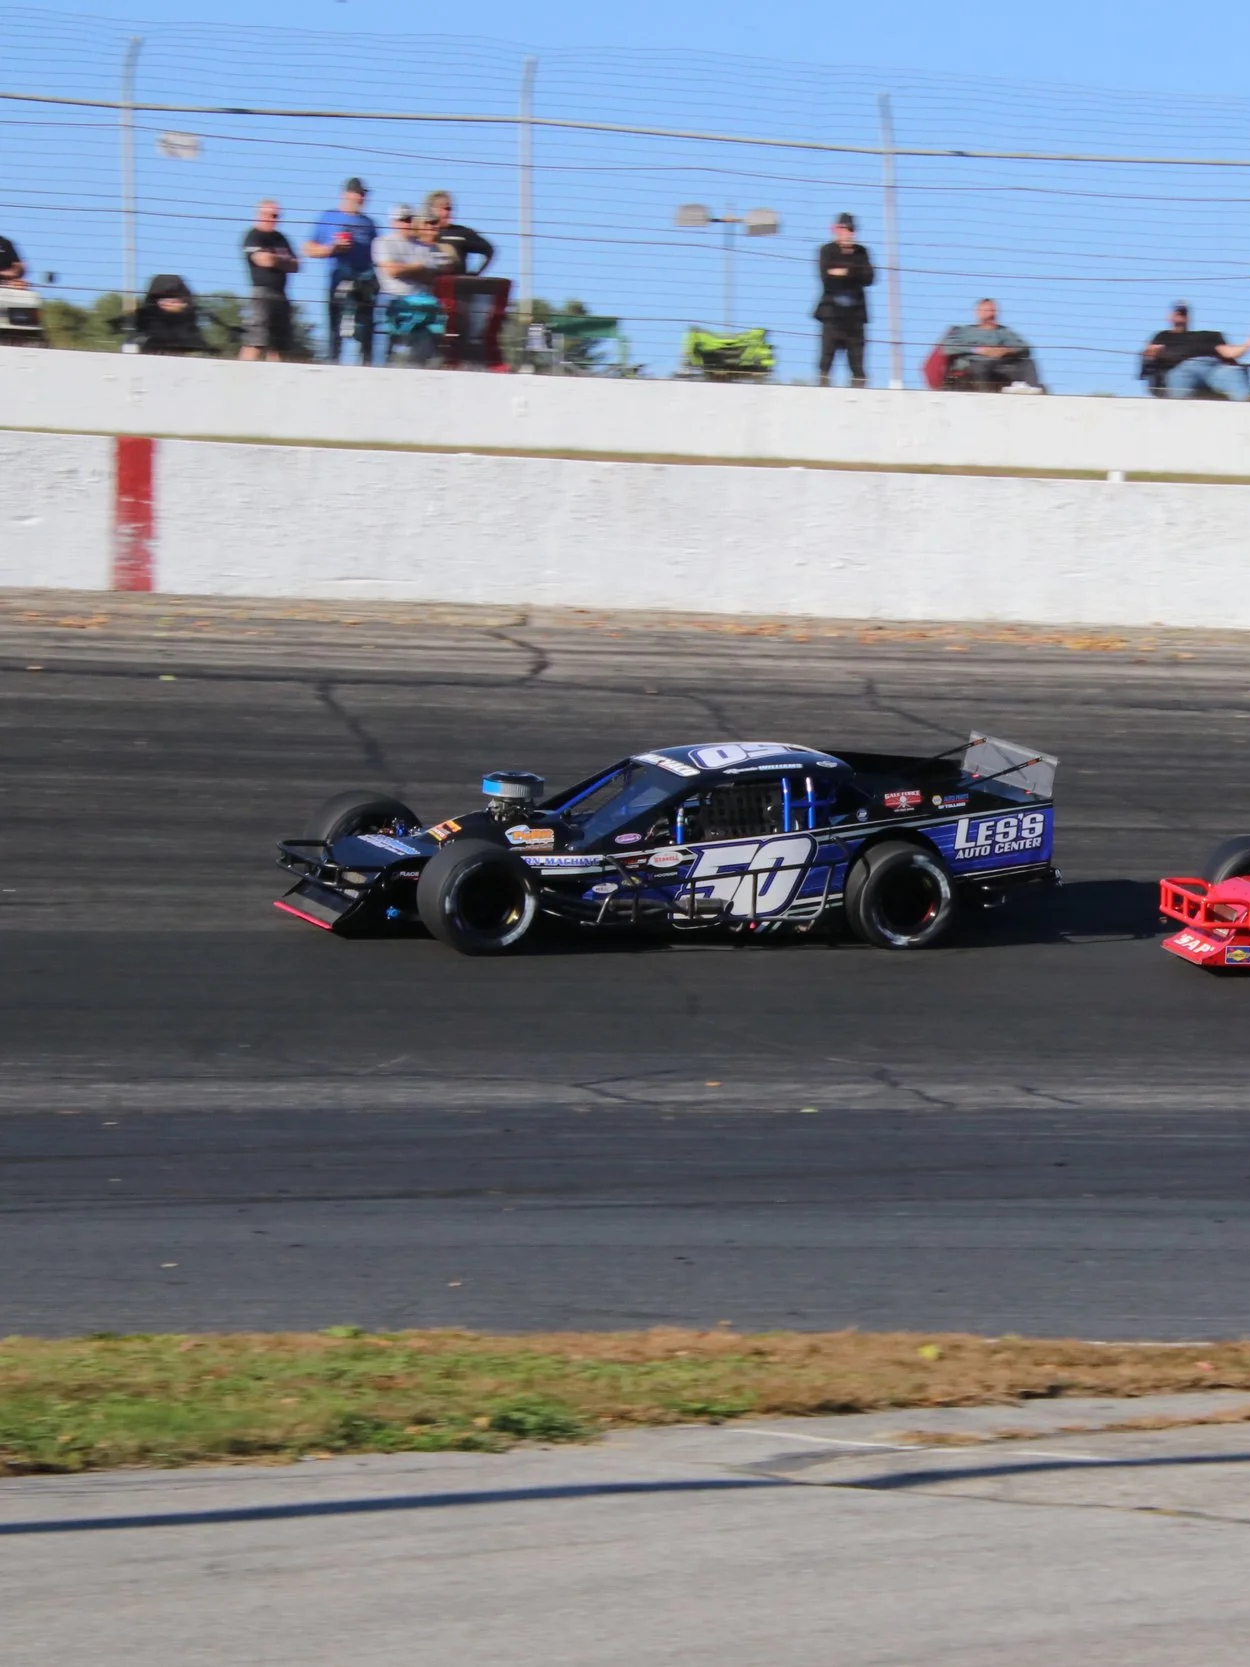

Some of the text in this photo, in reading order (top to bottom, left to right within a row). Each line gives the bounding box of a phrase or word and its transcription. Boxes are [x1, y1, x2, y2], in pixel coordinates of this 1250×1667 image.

[954, 813, 1045, 850] LES'S
[955, 837, 1042, 860] AUTO CENTER
[668, 838, 816, 918] 50
